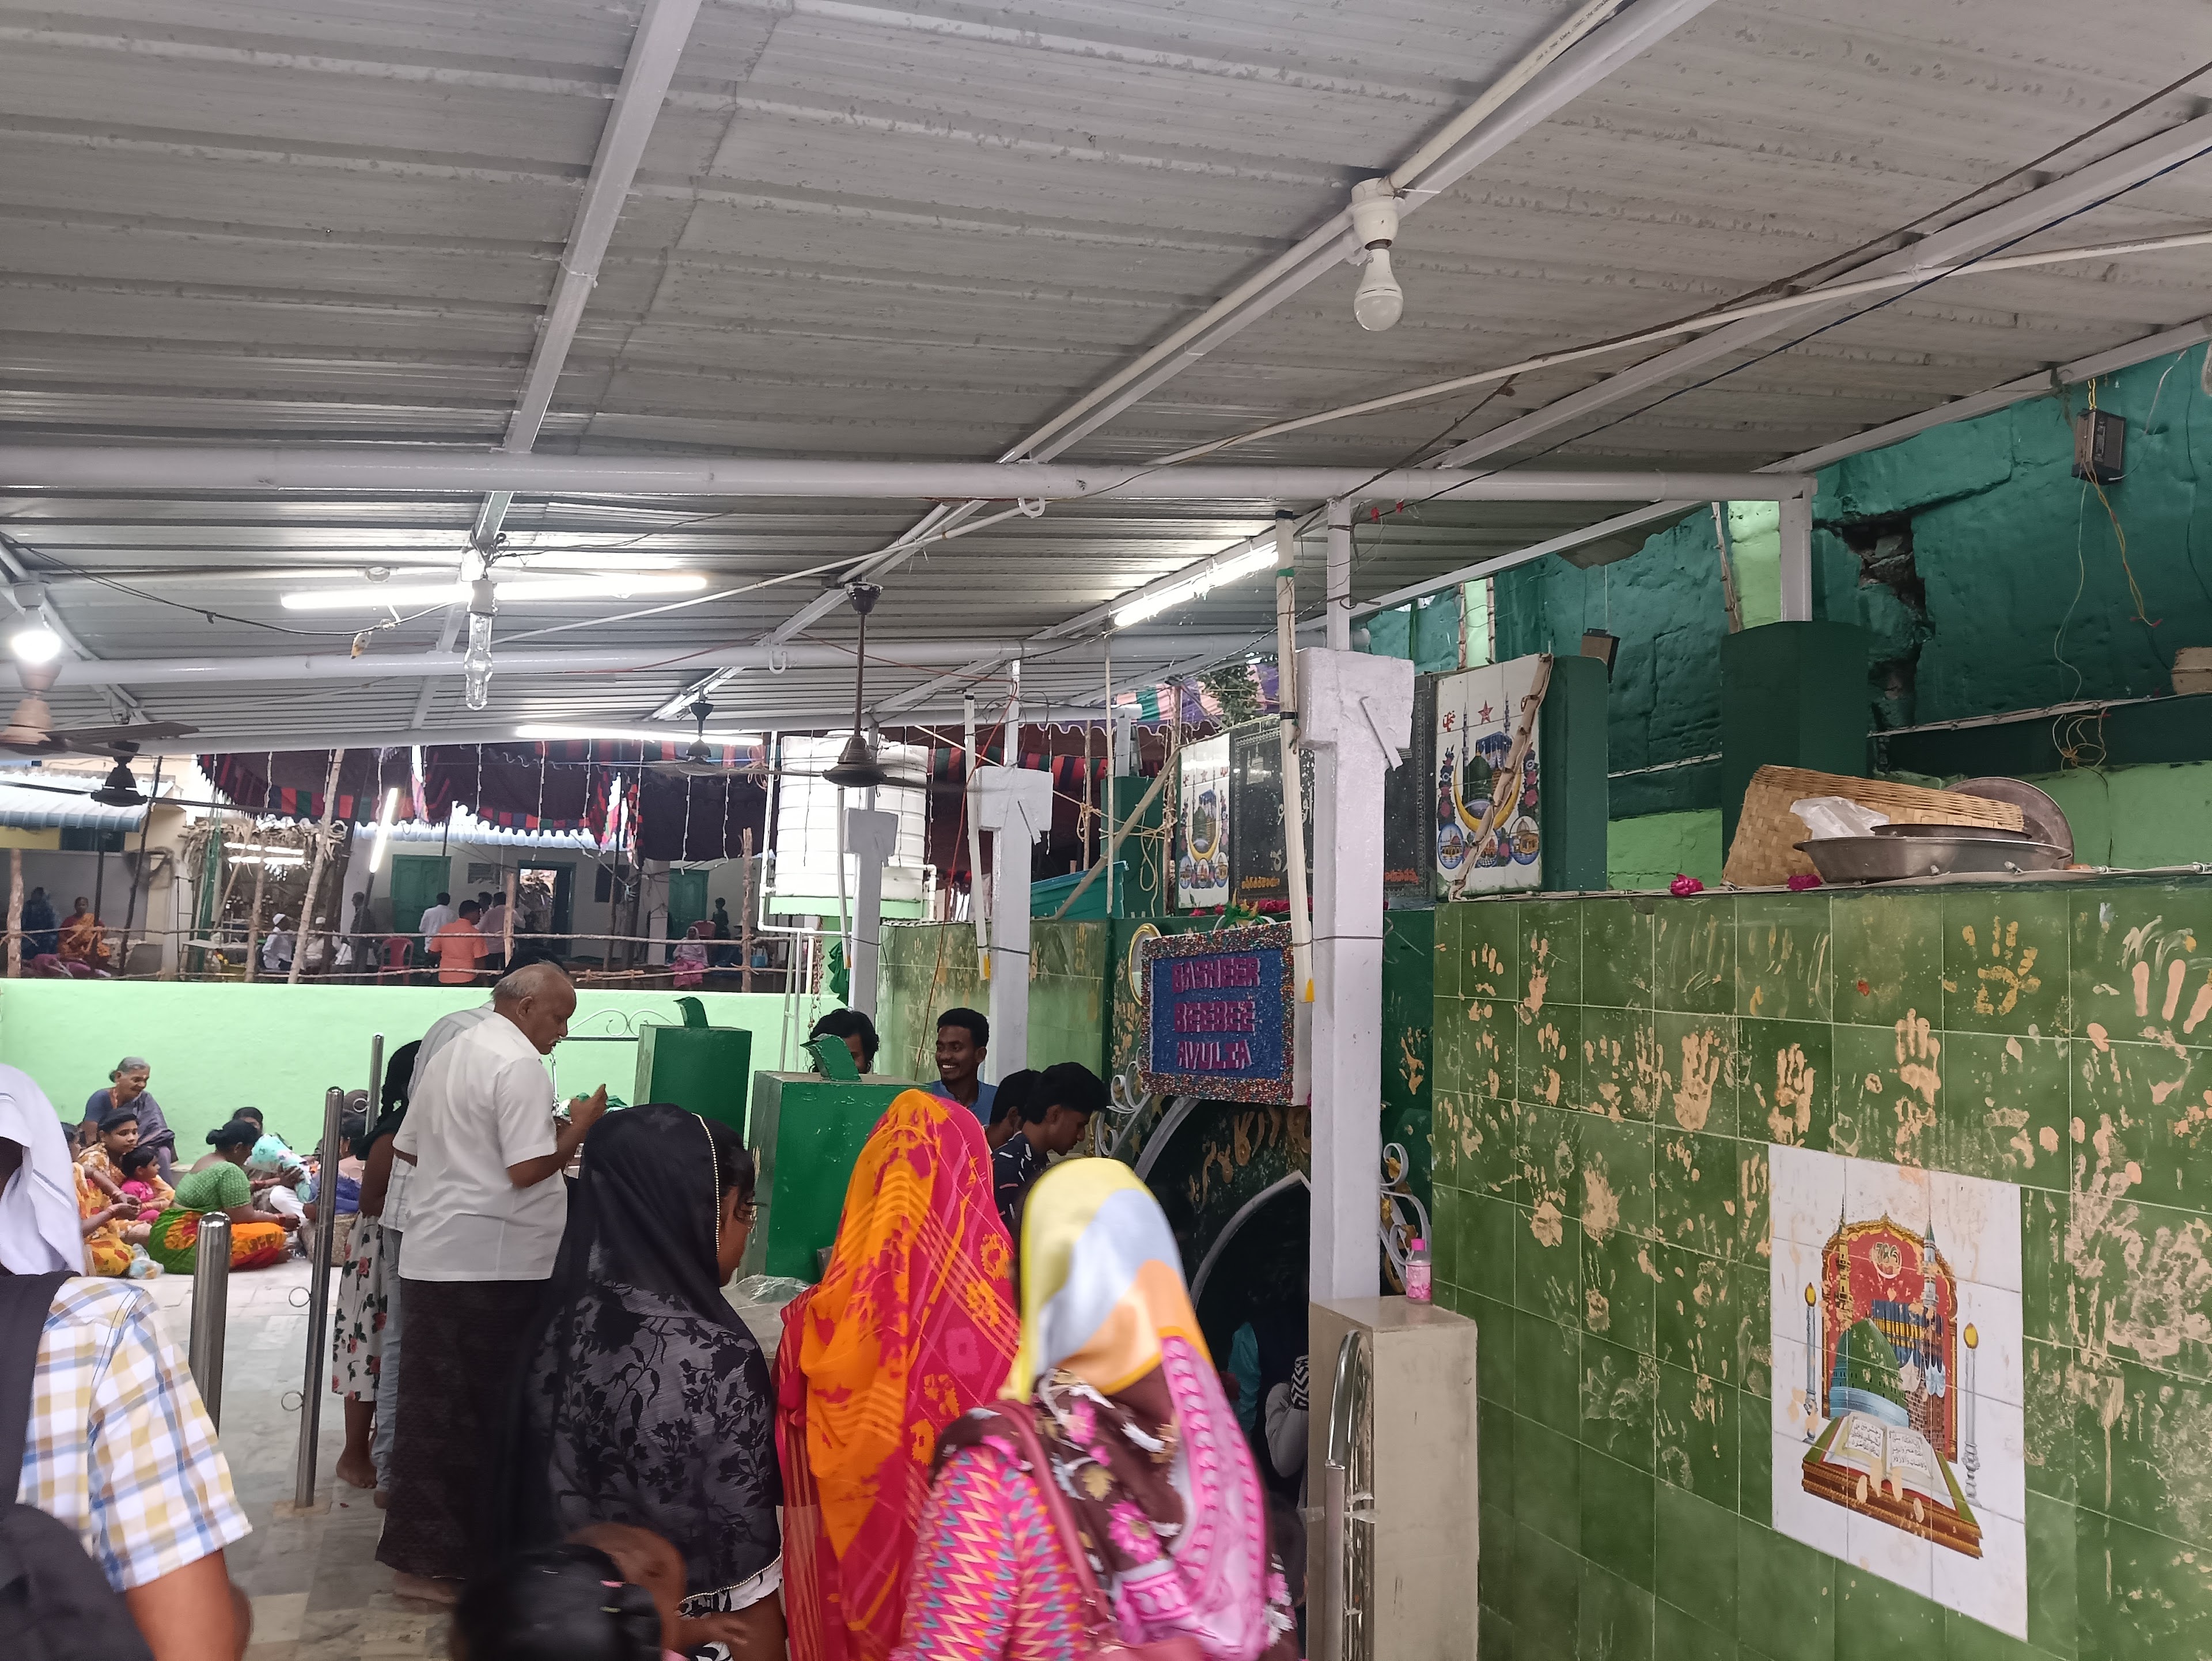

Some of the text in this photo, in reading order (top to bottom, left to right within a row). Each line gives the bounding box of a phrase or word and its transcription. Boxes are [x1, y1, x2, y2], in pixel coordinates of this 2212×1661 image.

[1172, 957, 1260, 993] BASHEER
[1174, 1001, 1256, 1032] BEEBEE
[1177, 1039, 1253, 1070] AVULIA
